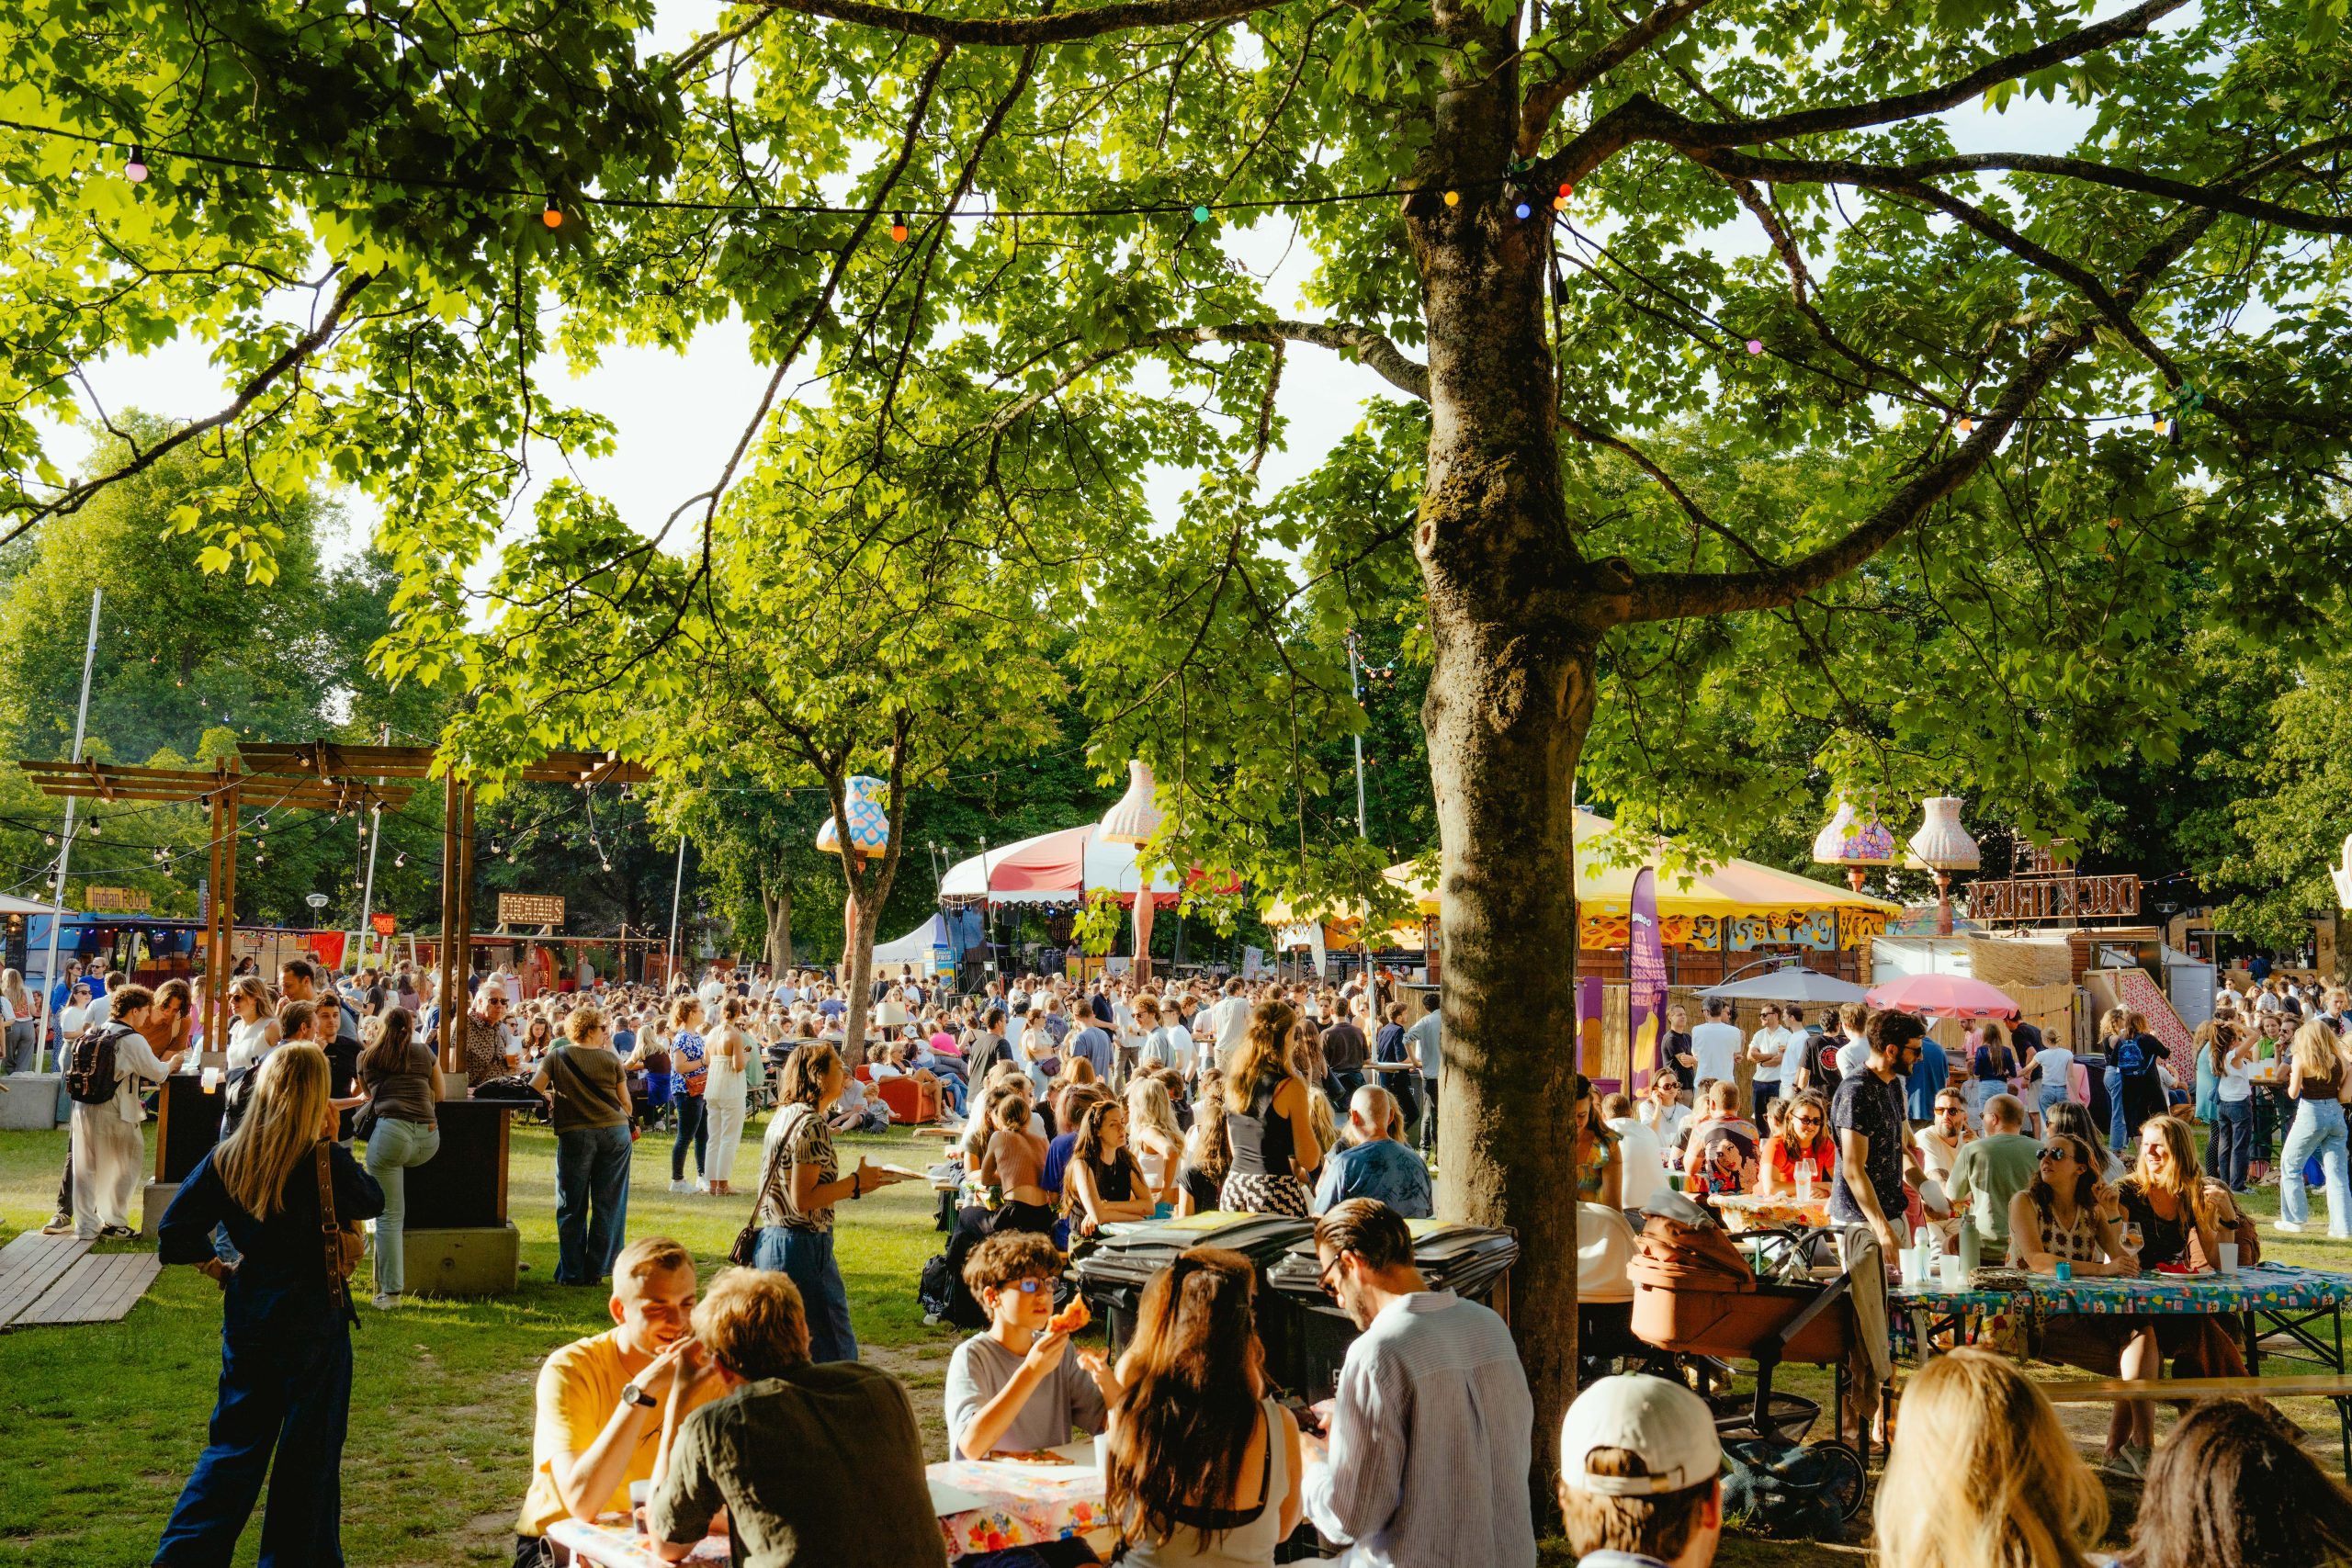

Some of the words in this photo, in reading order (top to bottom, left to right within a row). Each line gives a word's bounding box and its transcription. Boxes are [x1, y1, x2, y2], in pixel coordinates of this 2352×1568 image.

[92, 886, 119, 907] Indian
[122, 888, 147, 908] Food
[503, 896, 562, 921] COCKTAILS
